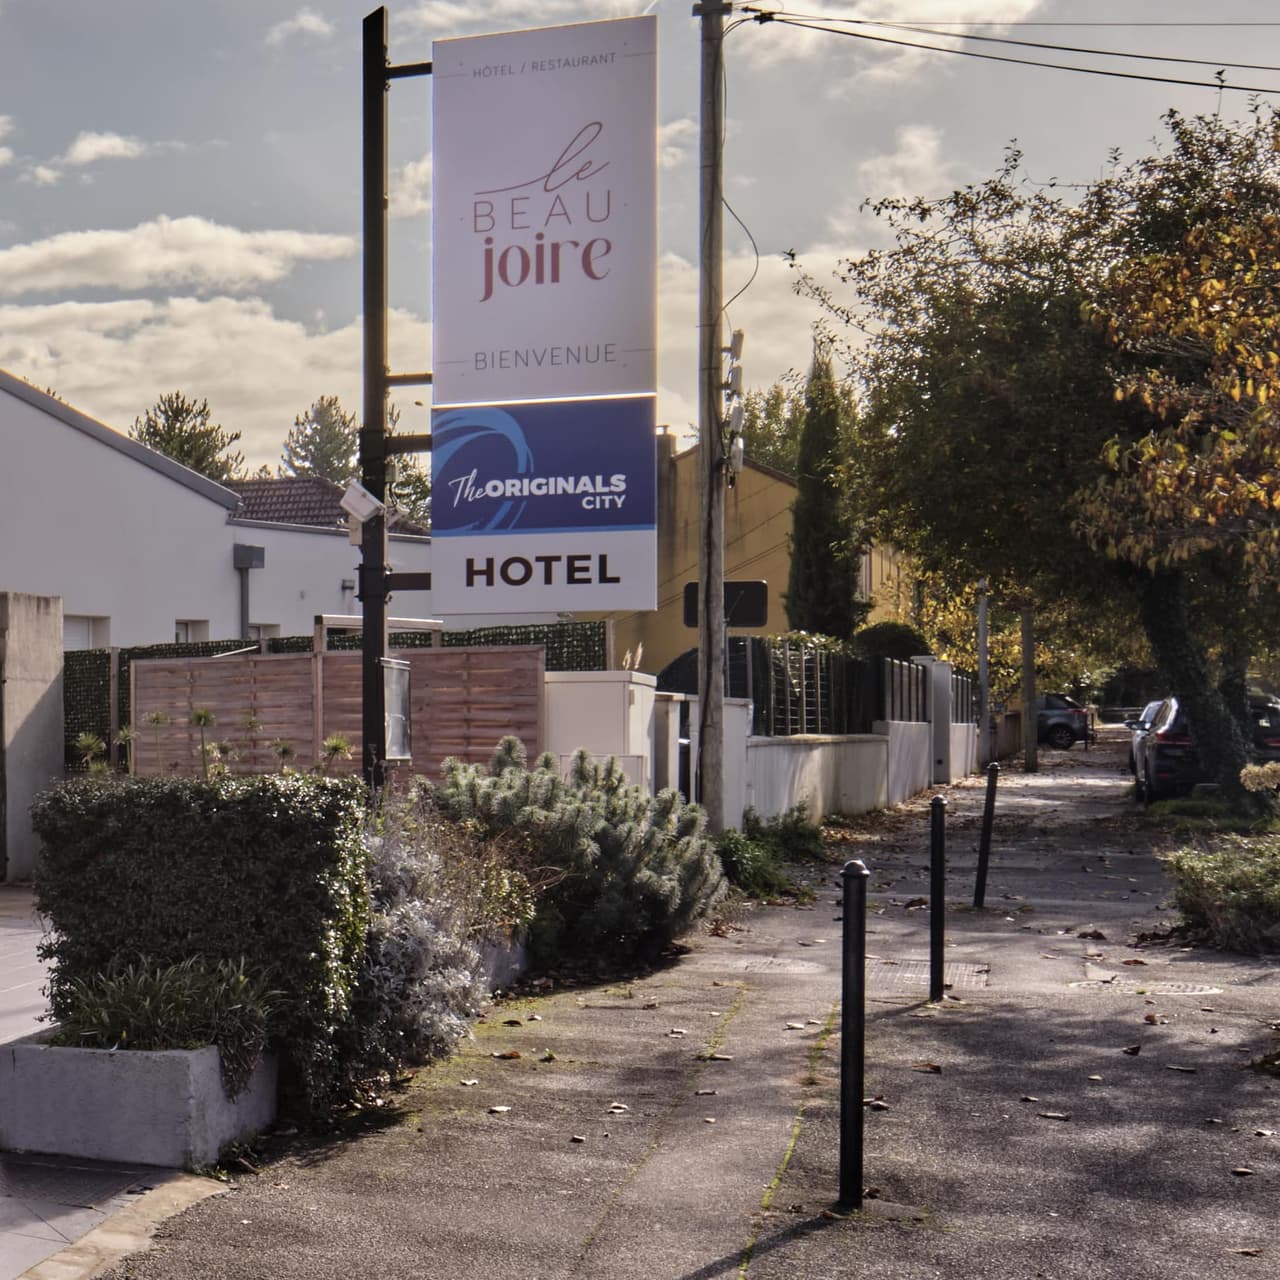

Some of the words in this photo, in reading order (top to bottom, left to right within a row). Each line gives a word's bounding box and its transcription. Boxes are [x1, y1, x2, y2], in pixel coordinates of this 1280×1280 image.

[472, 62, 516, 79] HÔTEL
[531, 52, 617, 72] RESTAURANT
[474, 121, 611, 193] le
[472, 189, 613, 234] BEAU
[480, 231, 613, 303] joire
[473, 343, 618, 371] BIENVENUE
[581, 495, 626, 510] CITY
[465, 553, 621, 587] HOTEL
